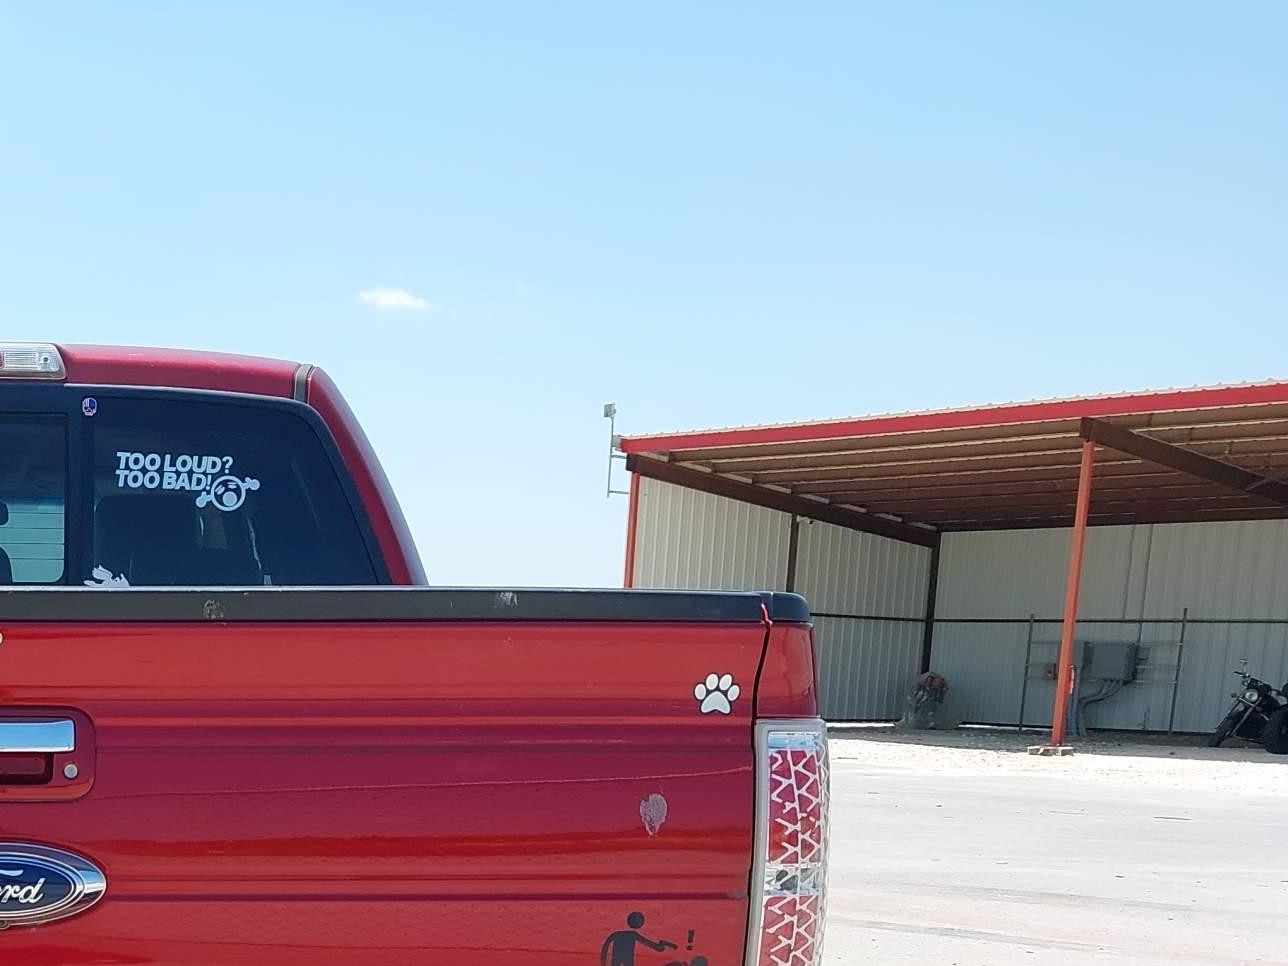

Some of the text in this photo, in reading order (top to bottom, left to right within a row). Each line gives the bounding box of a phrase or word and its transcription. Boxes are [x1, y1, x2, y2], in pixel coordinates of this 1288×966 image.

[116, 452, 233, 474] TOO LOUD?
[116, 470, 211, 491] TOO BAD!
